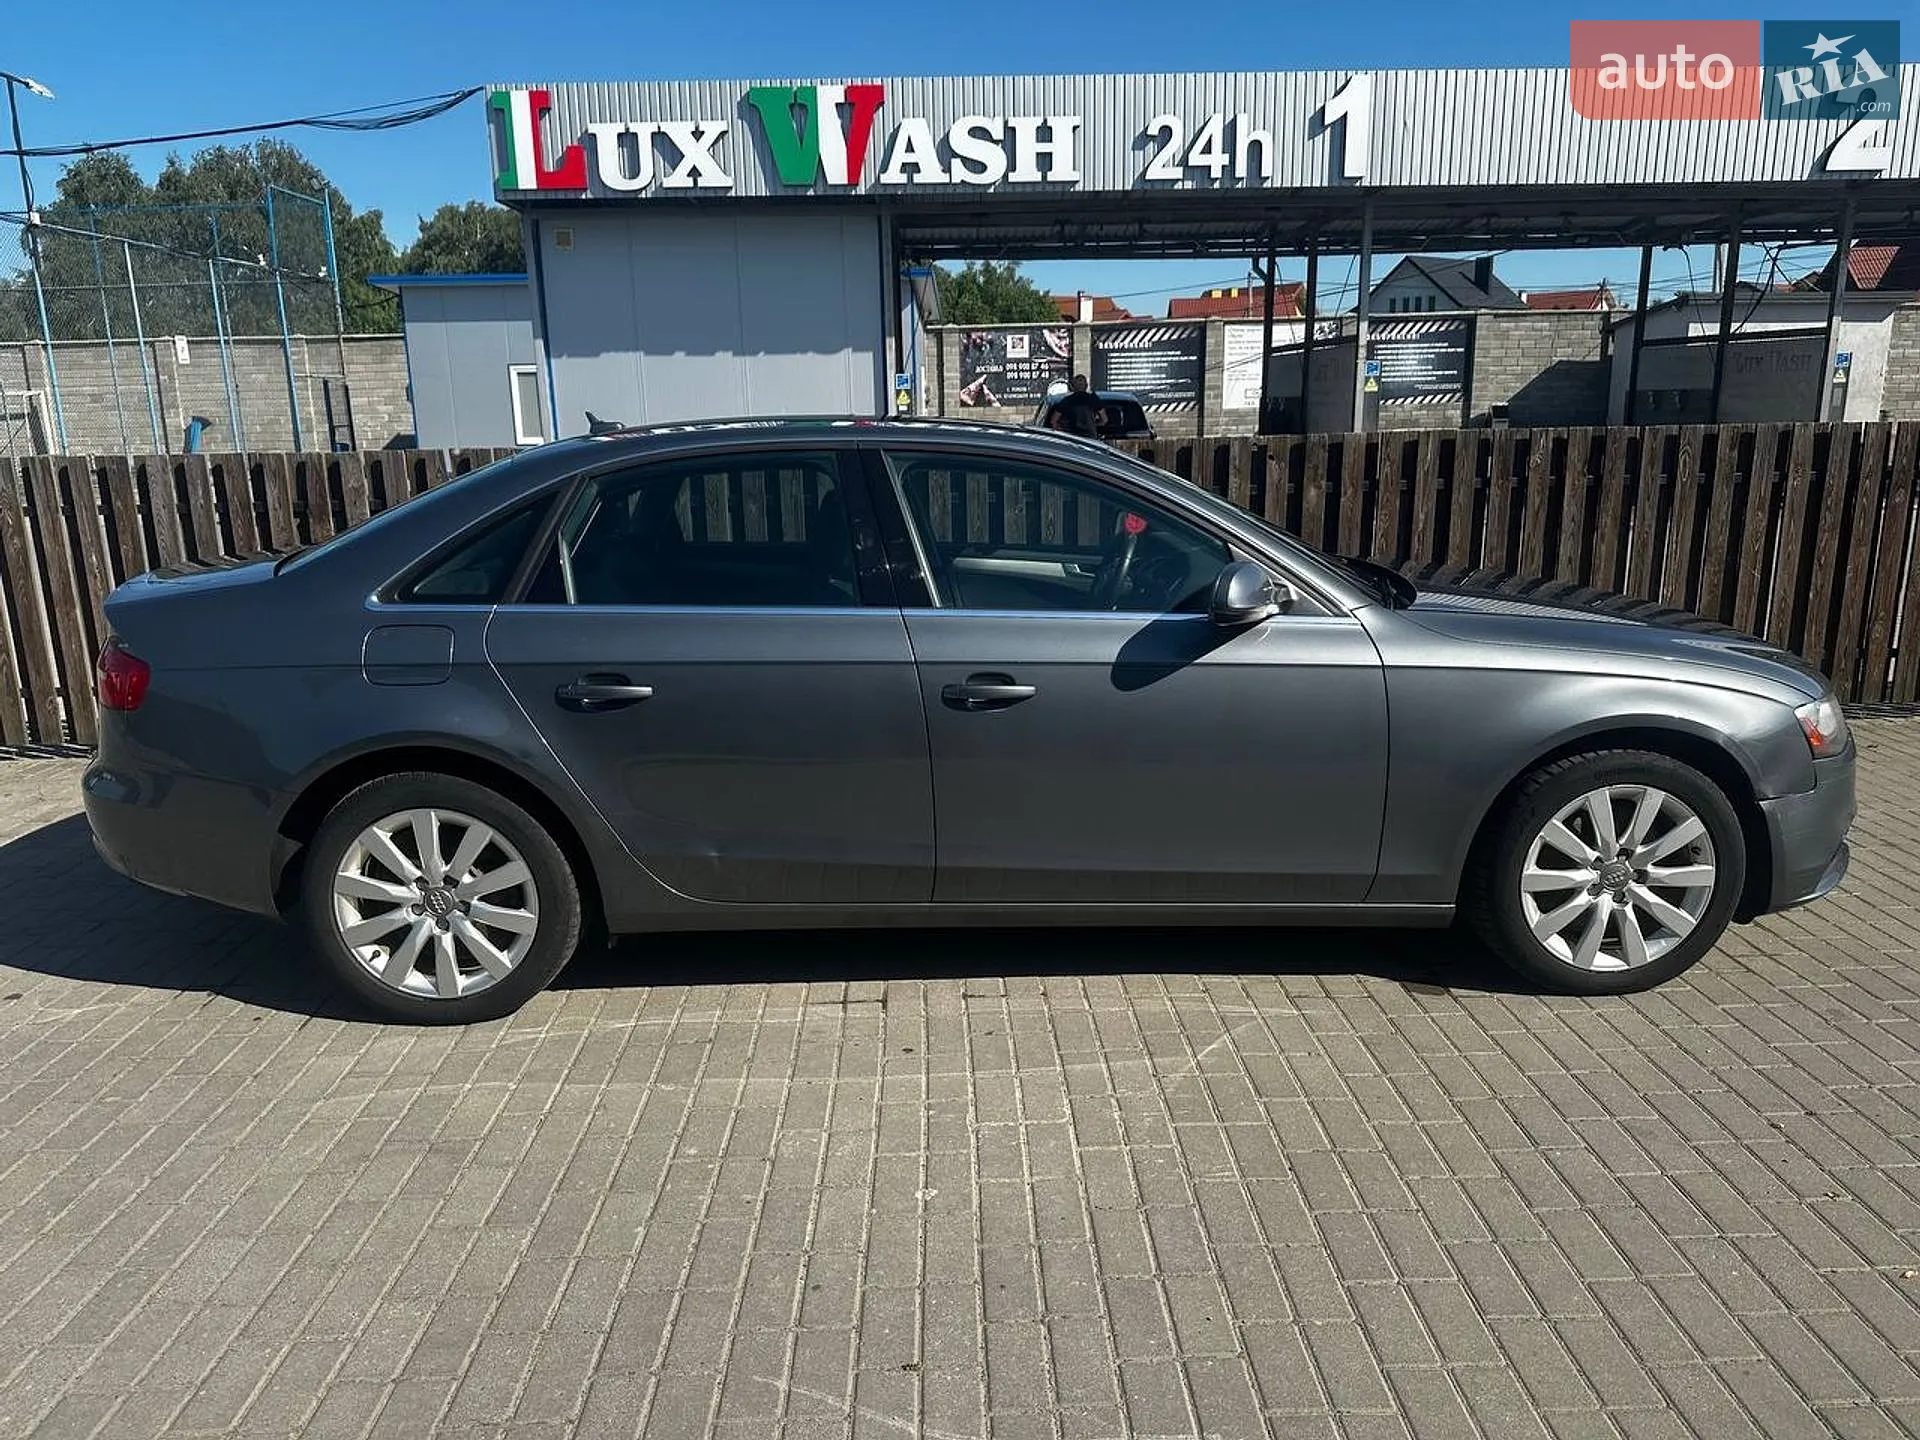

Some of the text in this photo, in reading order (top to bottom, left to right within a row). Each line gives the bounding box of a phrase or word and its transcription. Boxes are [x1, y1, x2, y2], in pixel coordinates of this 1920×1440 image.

[491, 84, 1081, 192] LUX WASH
[1145, 114, 1274, 181] 24h
[1321, 73, 1372, 179] 1
